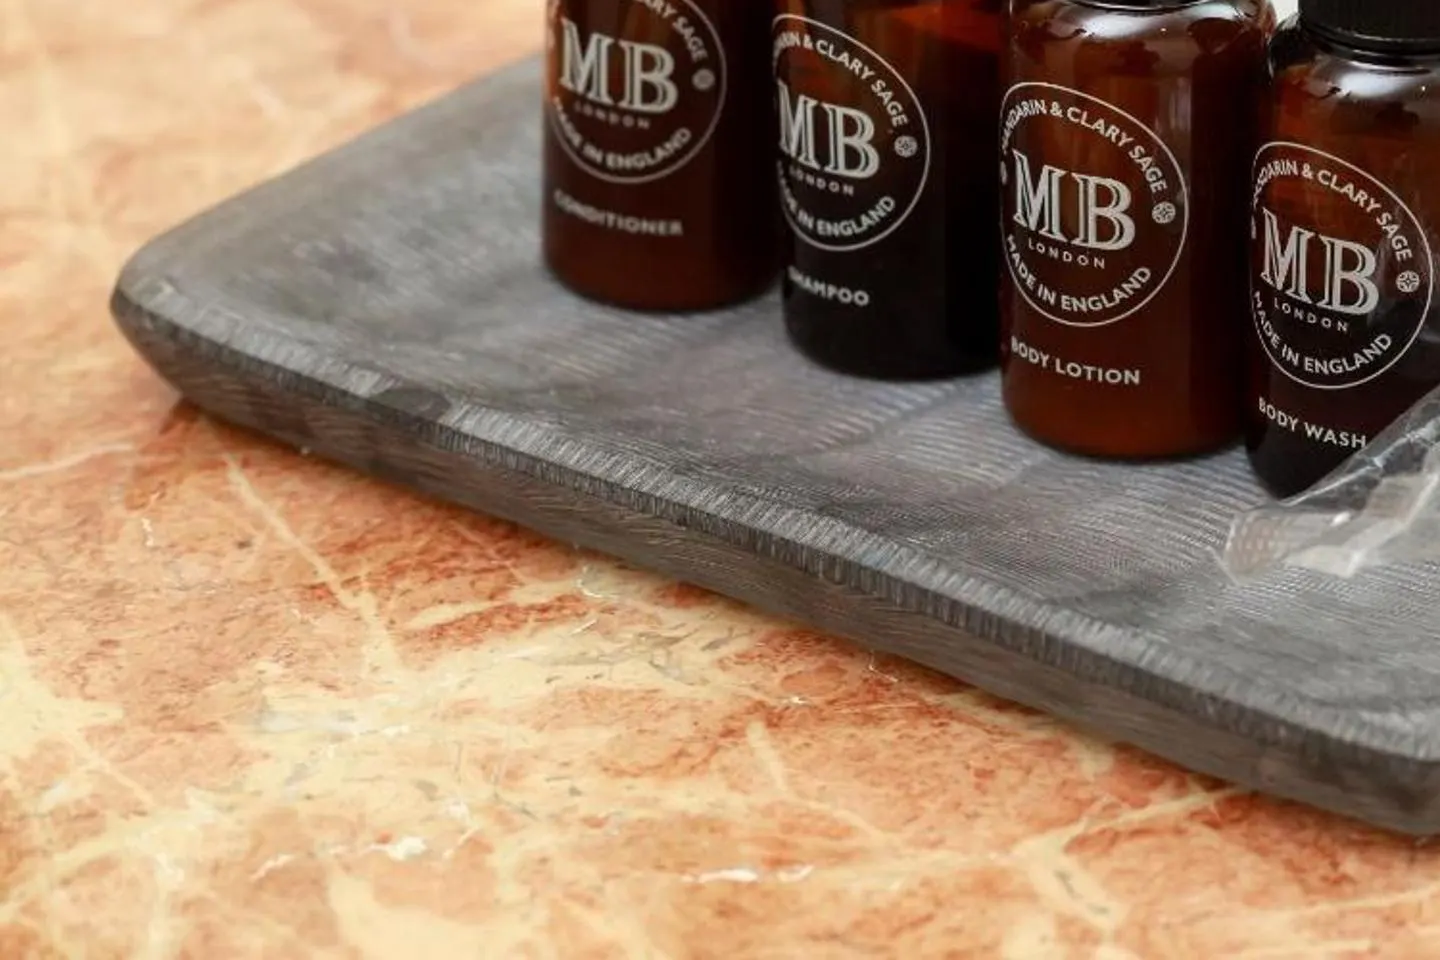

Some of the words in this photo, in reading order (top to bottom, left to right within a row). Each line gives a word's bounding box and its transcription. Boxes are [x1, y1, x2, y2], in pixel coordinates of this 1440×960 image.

[559, 16, 678, 114] MB
[672, 16, 709, 62] SAGE
[815, 39, 876, 81] CLARY
[870, 78, 910, 128] SAGE
[604, 127, 692, 170] ENGLAND
[776, 76, 881, 180] MB
[1050, 101, 1064, 119] &
[1066, 106, 1135, 148] CLARY
[1127, 144, 1169, 194] SAGE
[815, 194, 897, 238] ENGLAND
[1011, 147, 1137, 251] MB
[1301, 162, 1314, 180] &
[1316, 168, 1382, 214] CLARY
[1375, 211, 1414, 263] SAGE
[1027, 238, 1107, 270] LONDON
[1259, 205, 1381, 317] MB
[1037, 282, 1058, 307] IN
[1060, 266, 1153, 313] ENGLAND
[1272, 297, 1350, 334] LONDON
[1010, 334, 1050, 368] BODY
[1054, 356, 1142, 386] LOTION
[1281, 342, 1301, 367] IN
[1303, 332, 1394, 376] ENGLAND
[1257, 396, 1300, 433] BODY
[1303, 421, 1368, 450] WASH
